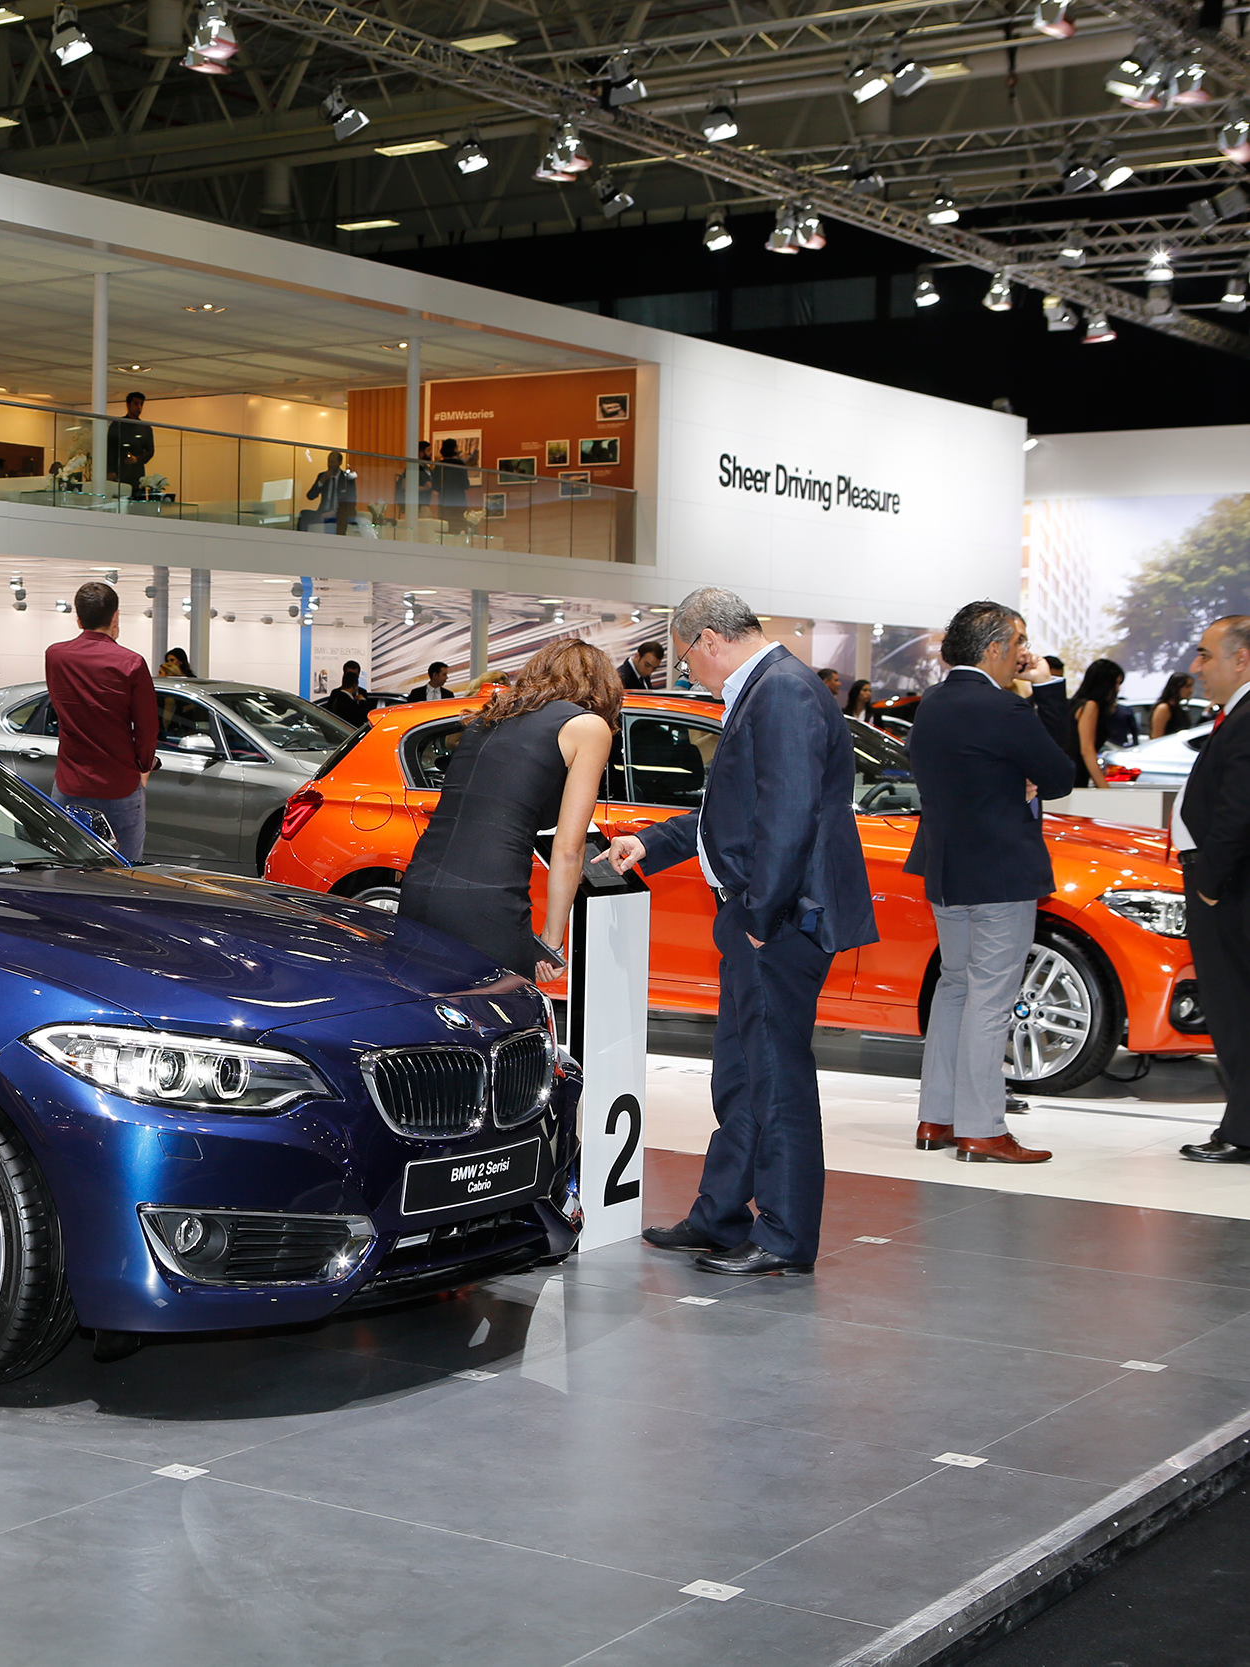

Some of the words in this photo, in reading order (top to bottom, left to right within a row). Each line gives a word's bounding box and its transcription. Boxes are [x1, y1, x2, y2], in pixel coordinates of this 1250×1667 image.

[434, 409, 494, 421] #BMWstories
[719, 453, 771, 493] Sheer
[775, 464, 831, 511] Driving
[836, 475, 900, 514] Pleasure
[604, 1093, 642, 1207] 2
[451, 1164, 478, 1182] BMW
[478, 1163, 485, 1177] 2
[486, 1156, 511, 1175] Serisi
[468, 1179, 492, 1193] Cabrio
